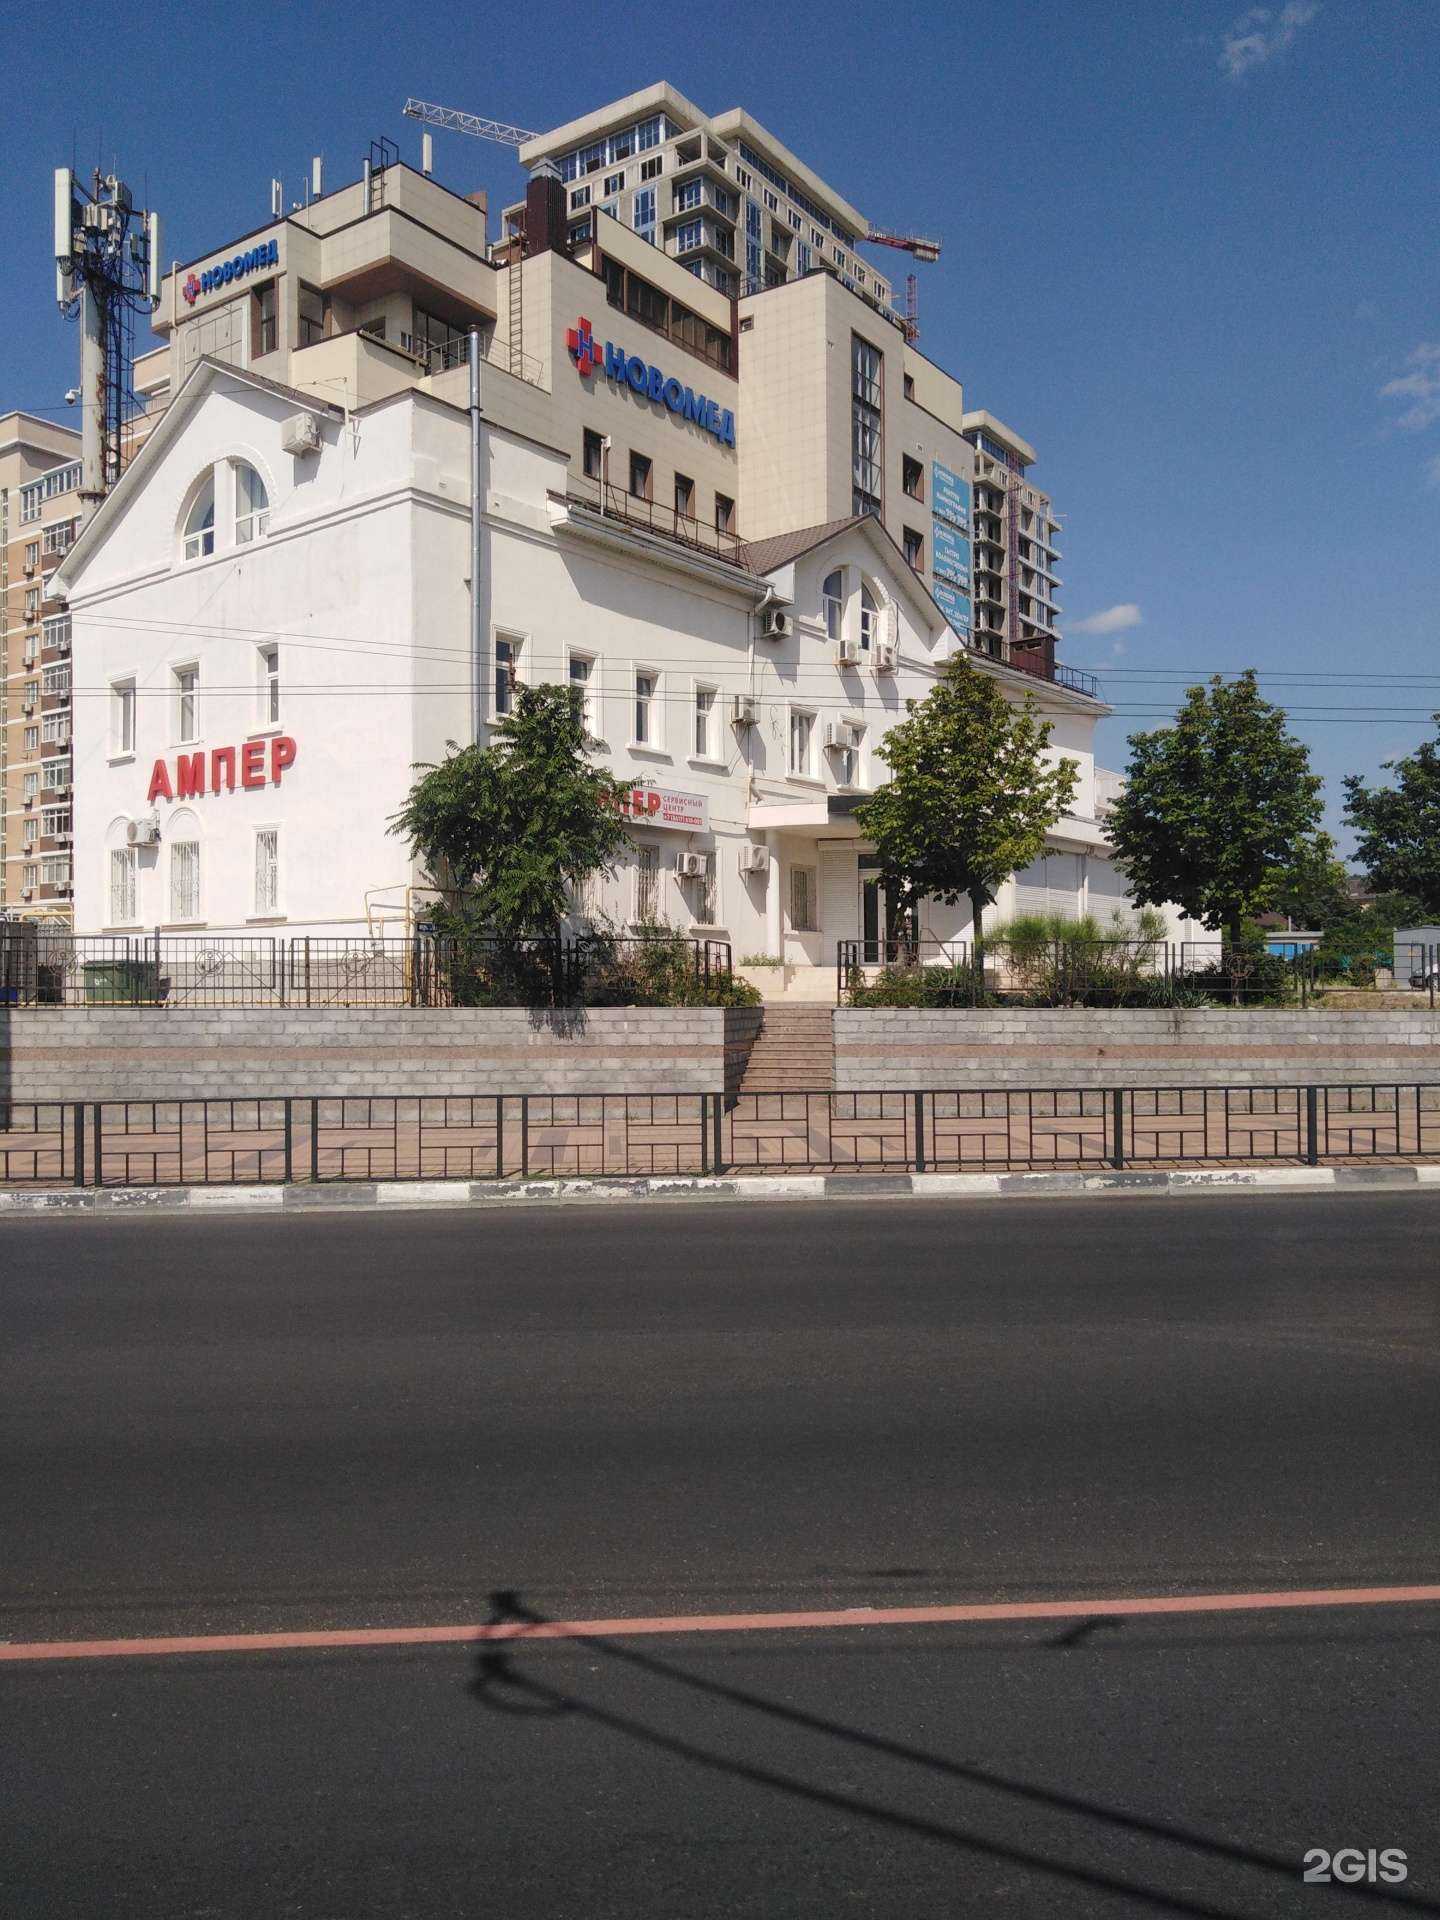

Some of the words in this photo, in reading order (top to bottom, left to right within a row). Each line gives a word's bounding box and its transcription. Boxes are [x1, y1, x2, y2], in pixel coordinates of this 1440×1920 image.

[201, 239, 279, 293] НОВОМЕД
[606, 341, 736, 449] НОВОМЕД
[147, 736, 297, 801] АМПЕР
[663, 795, 703, 808] СЕРВИСНЫЙ
[663, 803, 684, 813] ЦЕНТР
